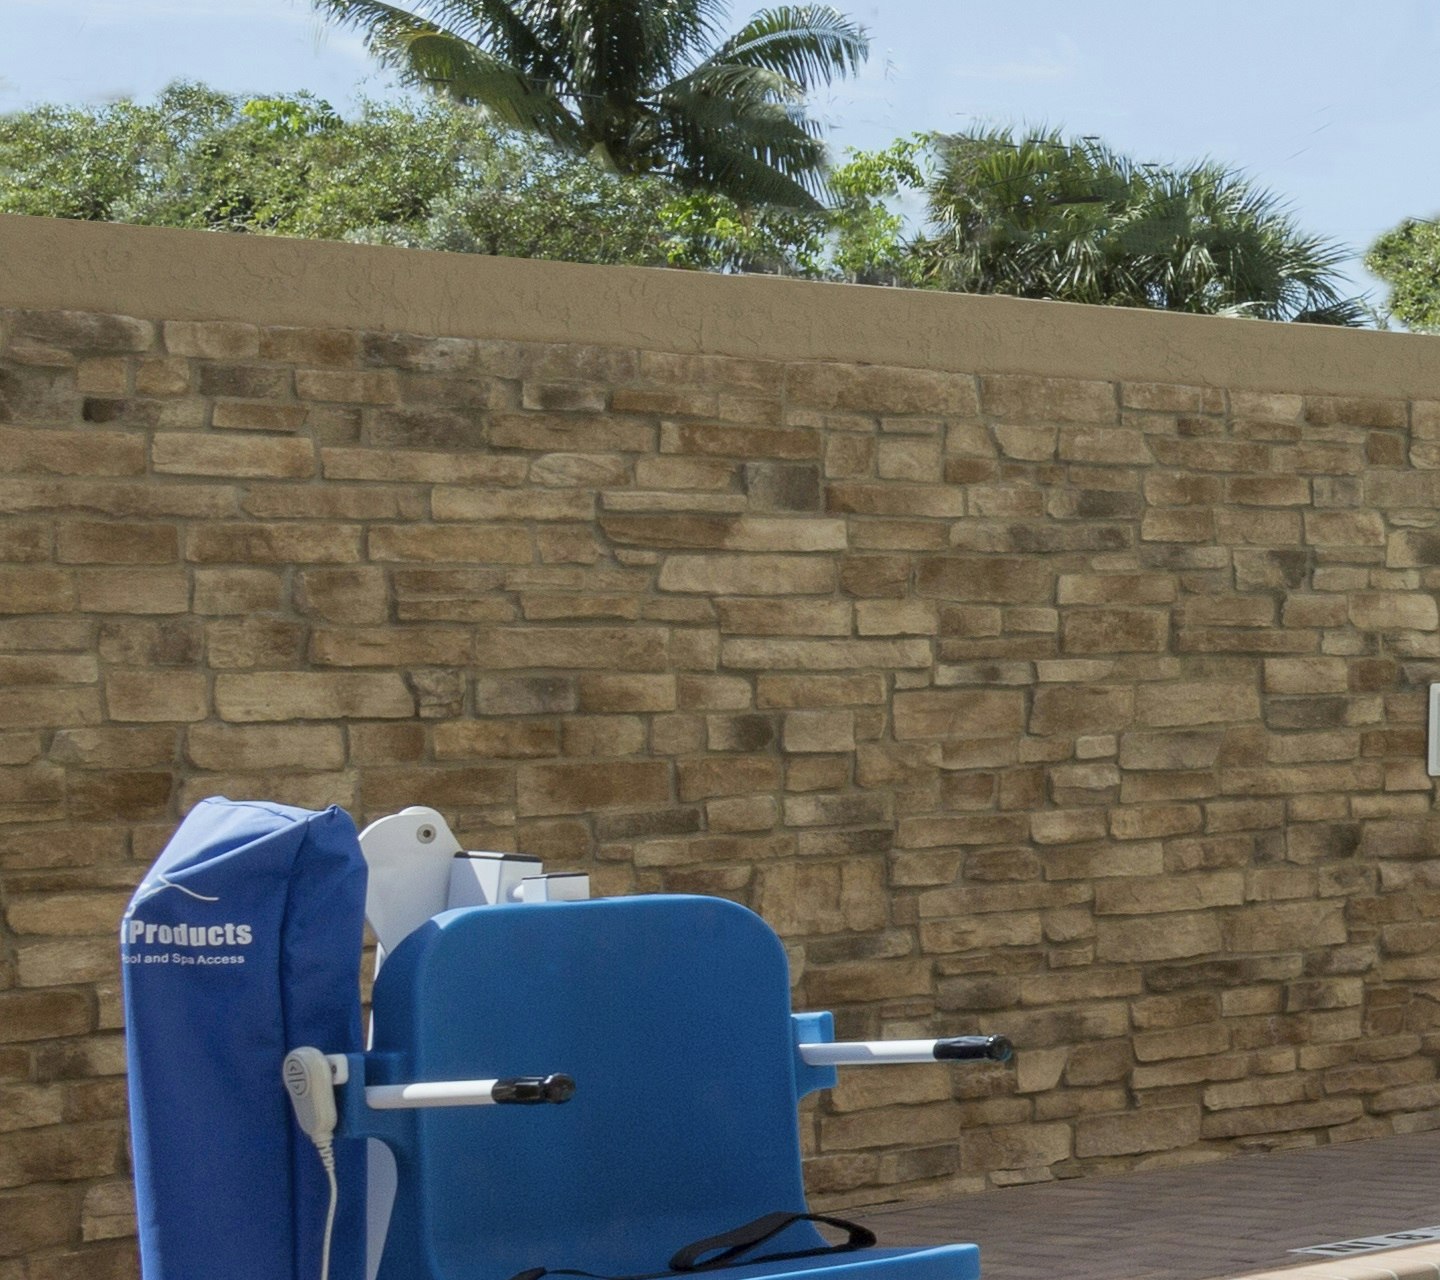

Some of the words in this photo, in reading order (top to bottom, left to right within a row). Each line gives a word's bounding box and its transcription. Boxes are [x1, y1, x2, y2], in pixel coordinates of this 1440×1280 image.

[129, 920, 253, 946] Products
[144, 953, 169, 964] and
[172, 953, 194, 965] Spa
[197, 955, 245, 964] Access
